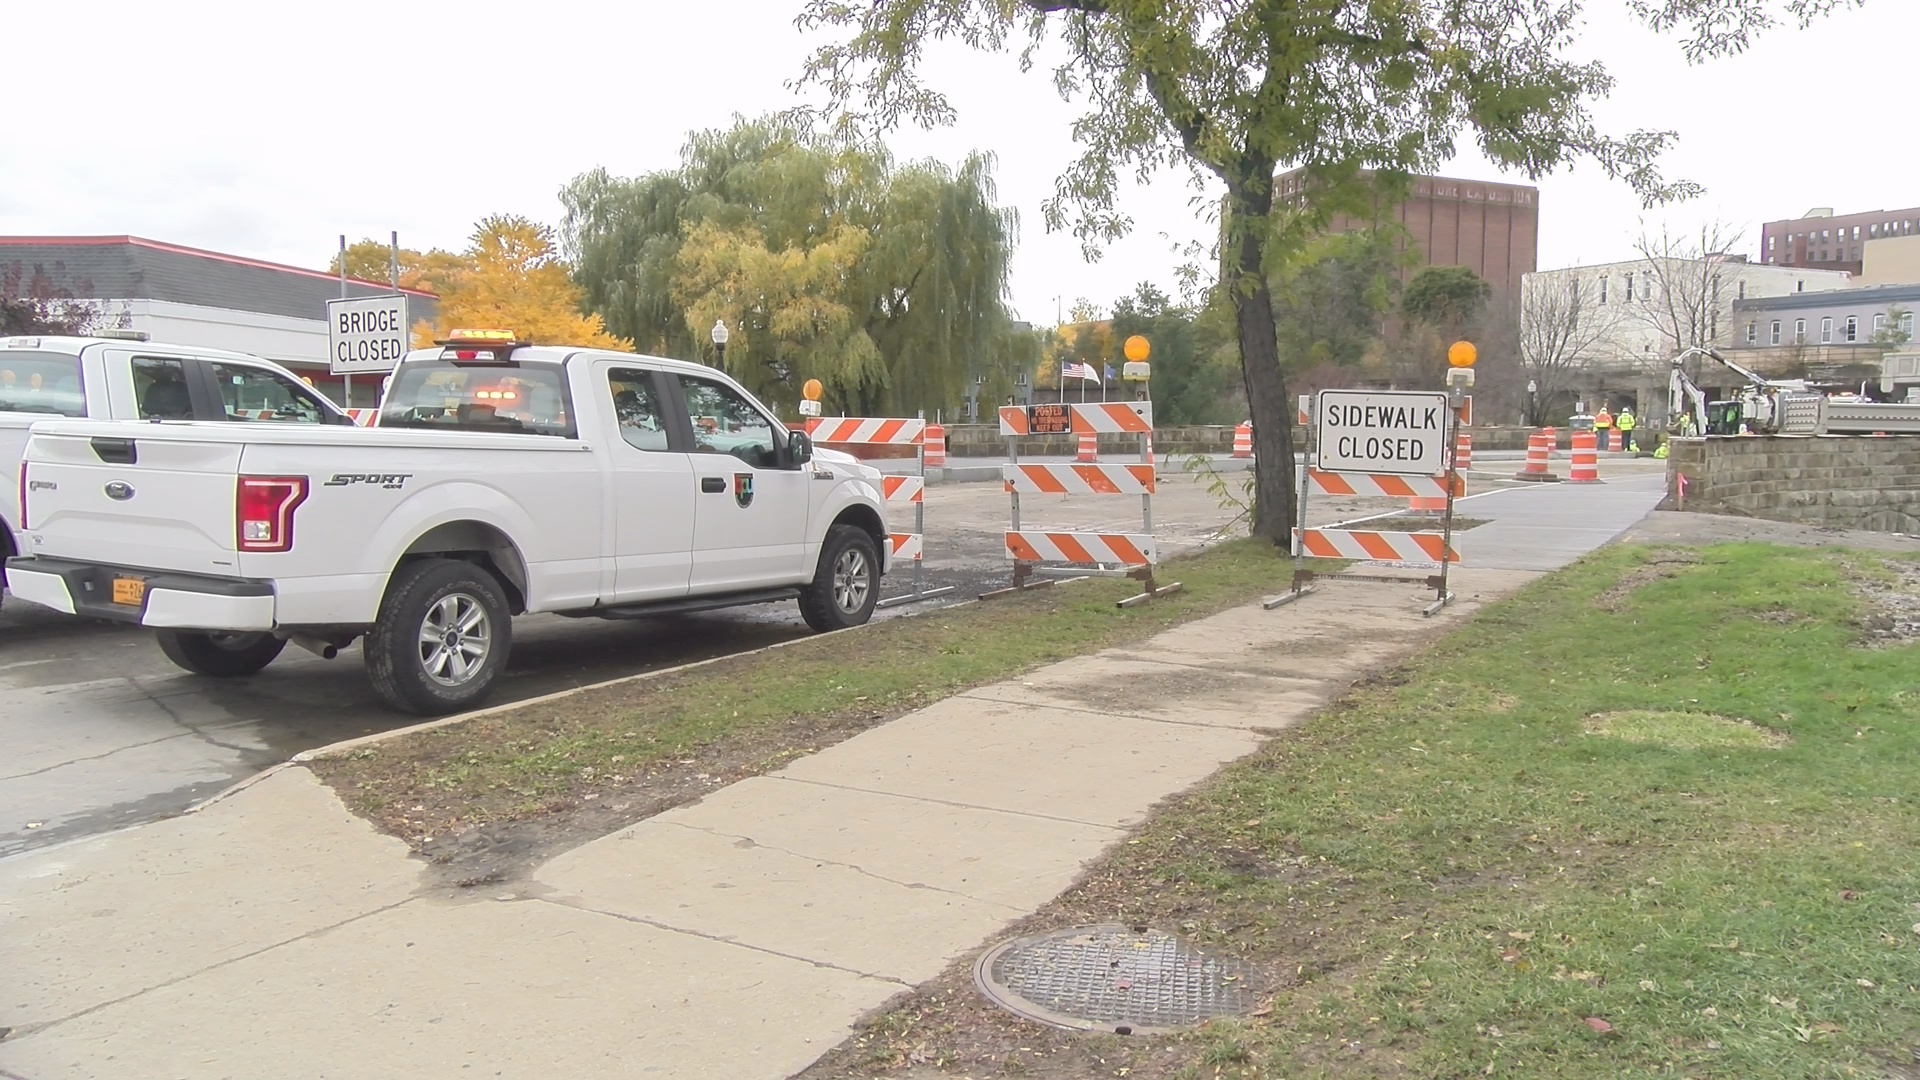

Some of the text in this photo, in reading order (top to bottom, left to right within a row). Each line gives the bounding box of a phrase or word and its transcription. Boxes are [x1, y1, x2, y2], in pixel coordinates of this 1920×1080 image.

[340, 310, 399, 333] BRIDGE
[338, 339, 401, 362] CLOSED
[1034, 406, 1063, 417] POSTED
[1328, 404, 1437, 430] SIDEWALK
[1052, 423, 1063, 432] OUT
[1338, 436, 1423, 461] CLOSED
[324, 474, 413, 486] SPORT
